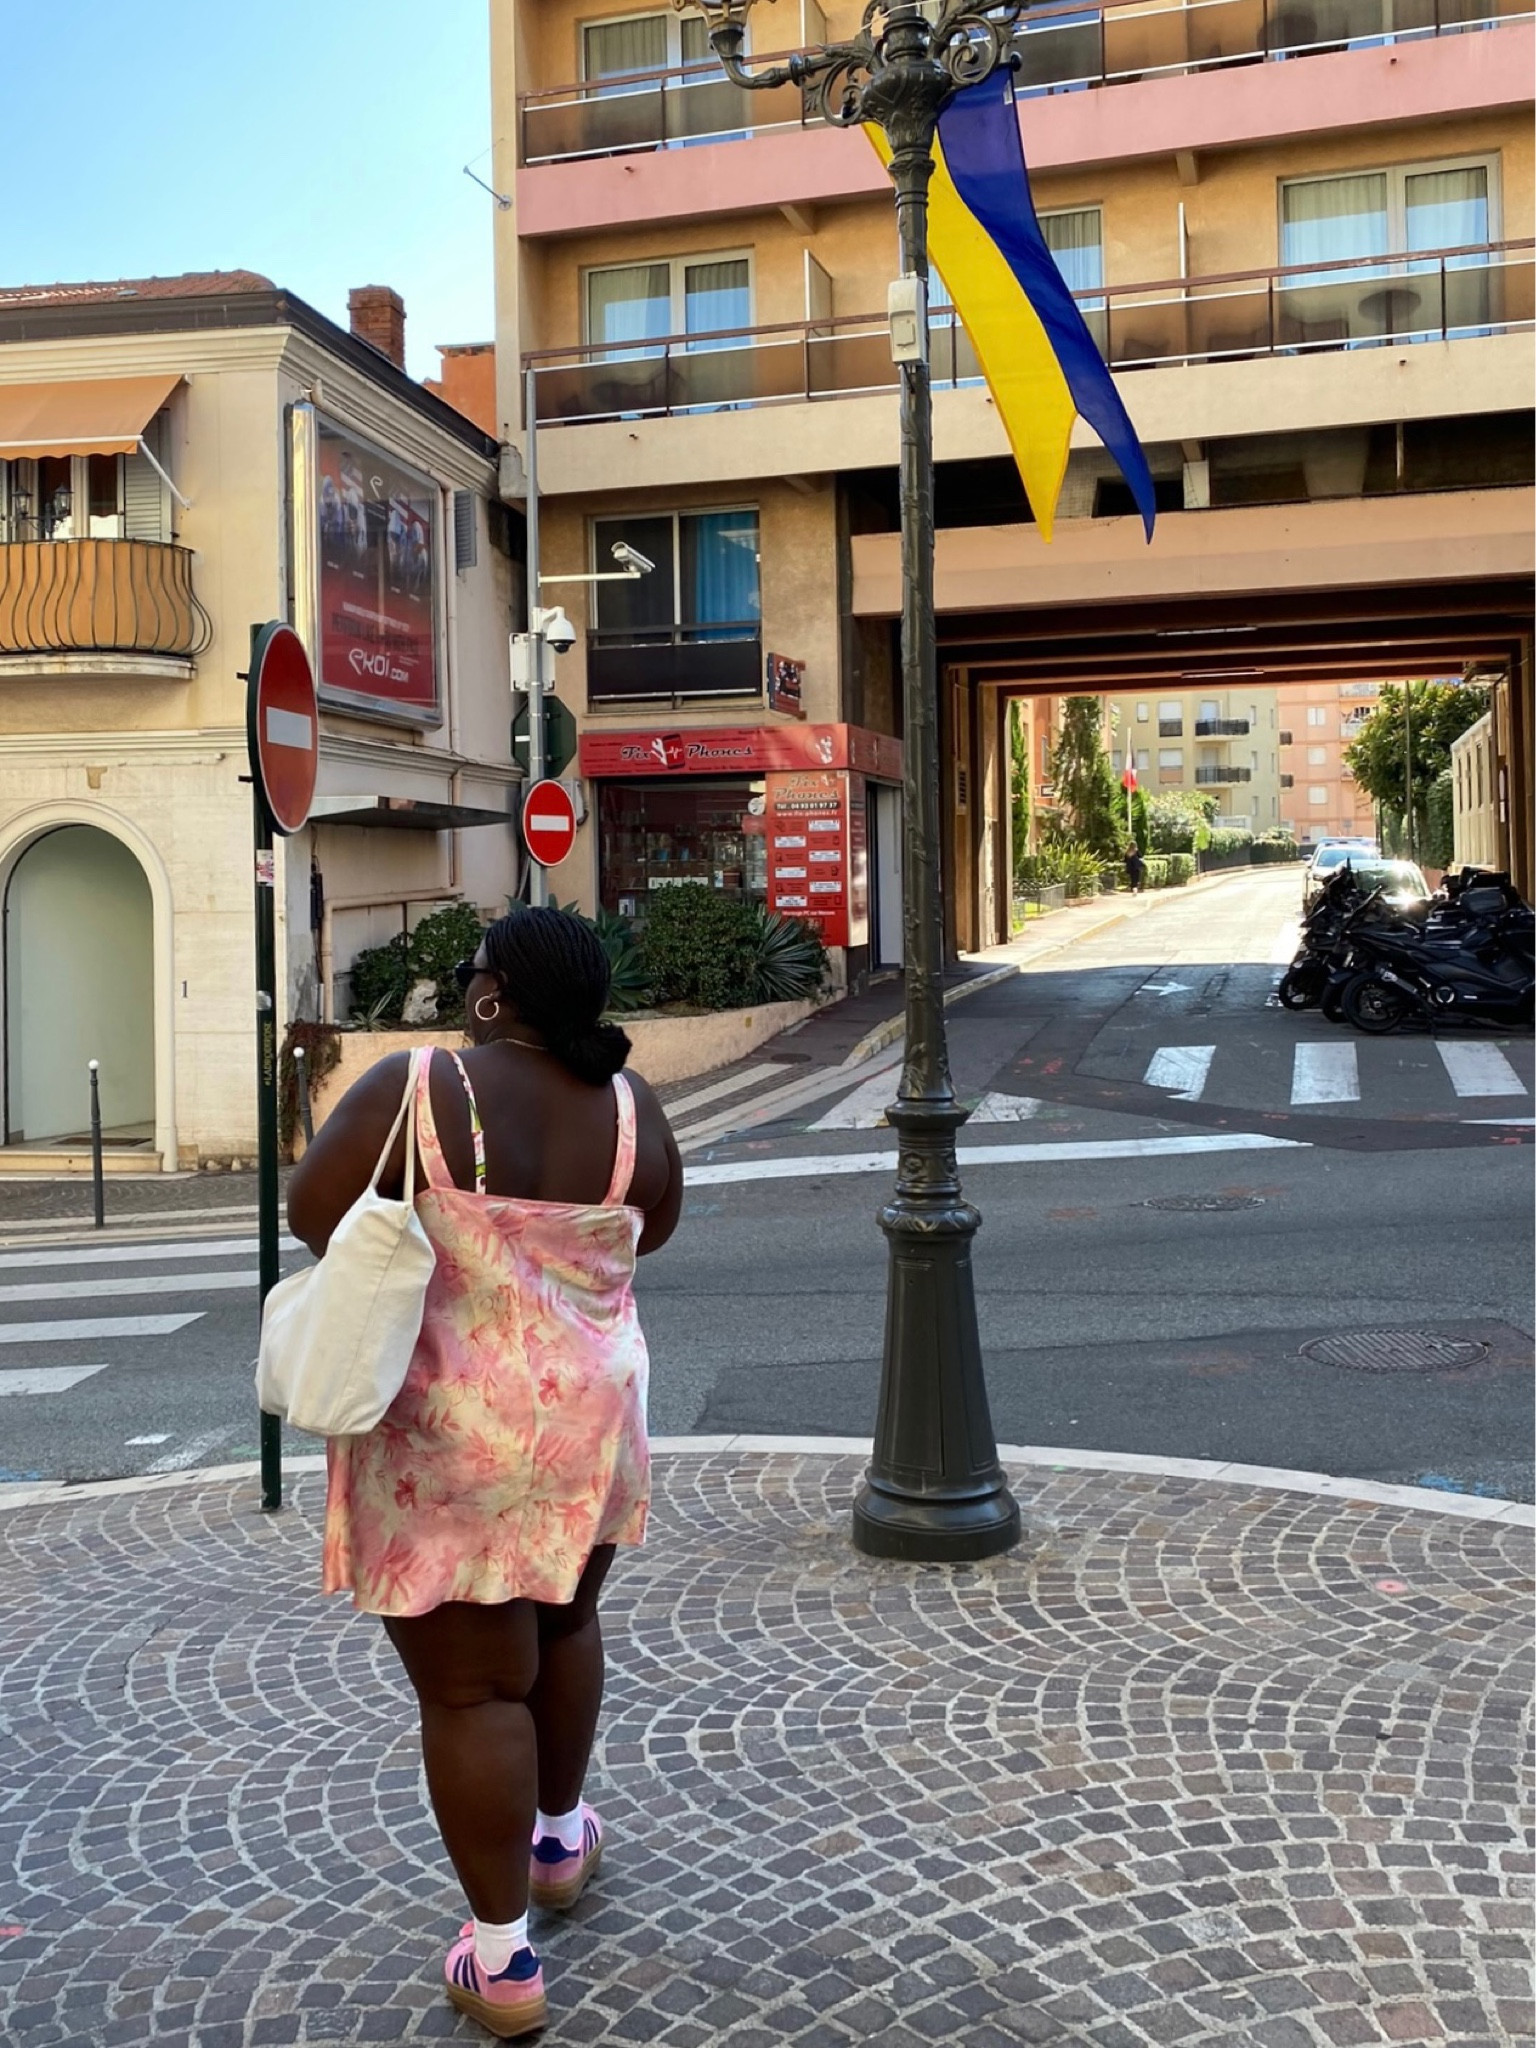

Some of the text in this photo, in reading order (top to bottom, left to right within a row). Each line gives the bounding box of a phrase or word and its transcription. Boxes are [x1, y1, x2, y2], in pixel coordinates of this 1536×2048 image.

[622, 743, 753, 761] Fix Phones
[790, 775, 816, 786] Fix
[774, 788, 839, 799] Phones
